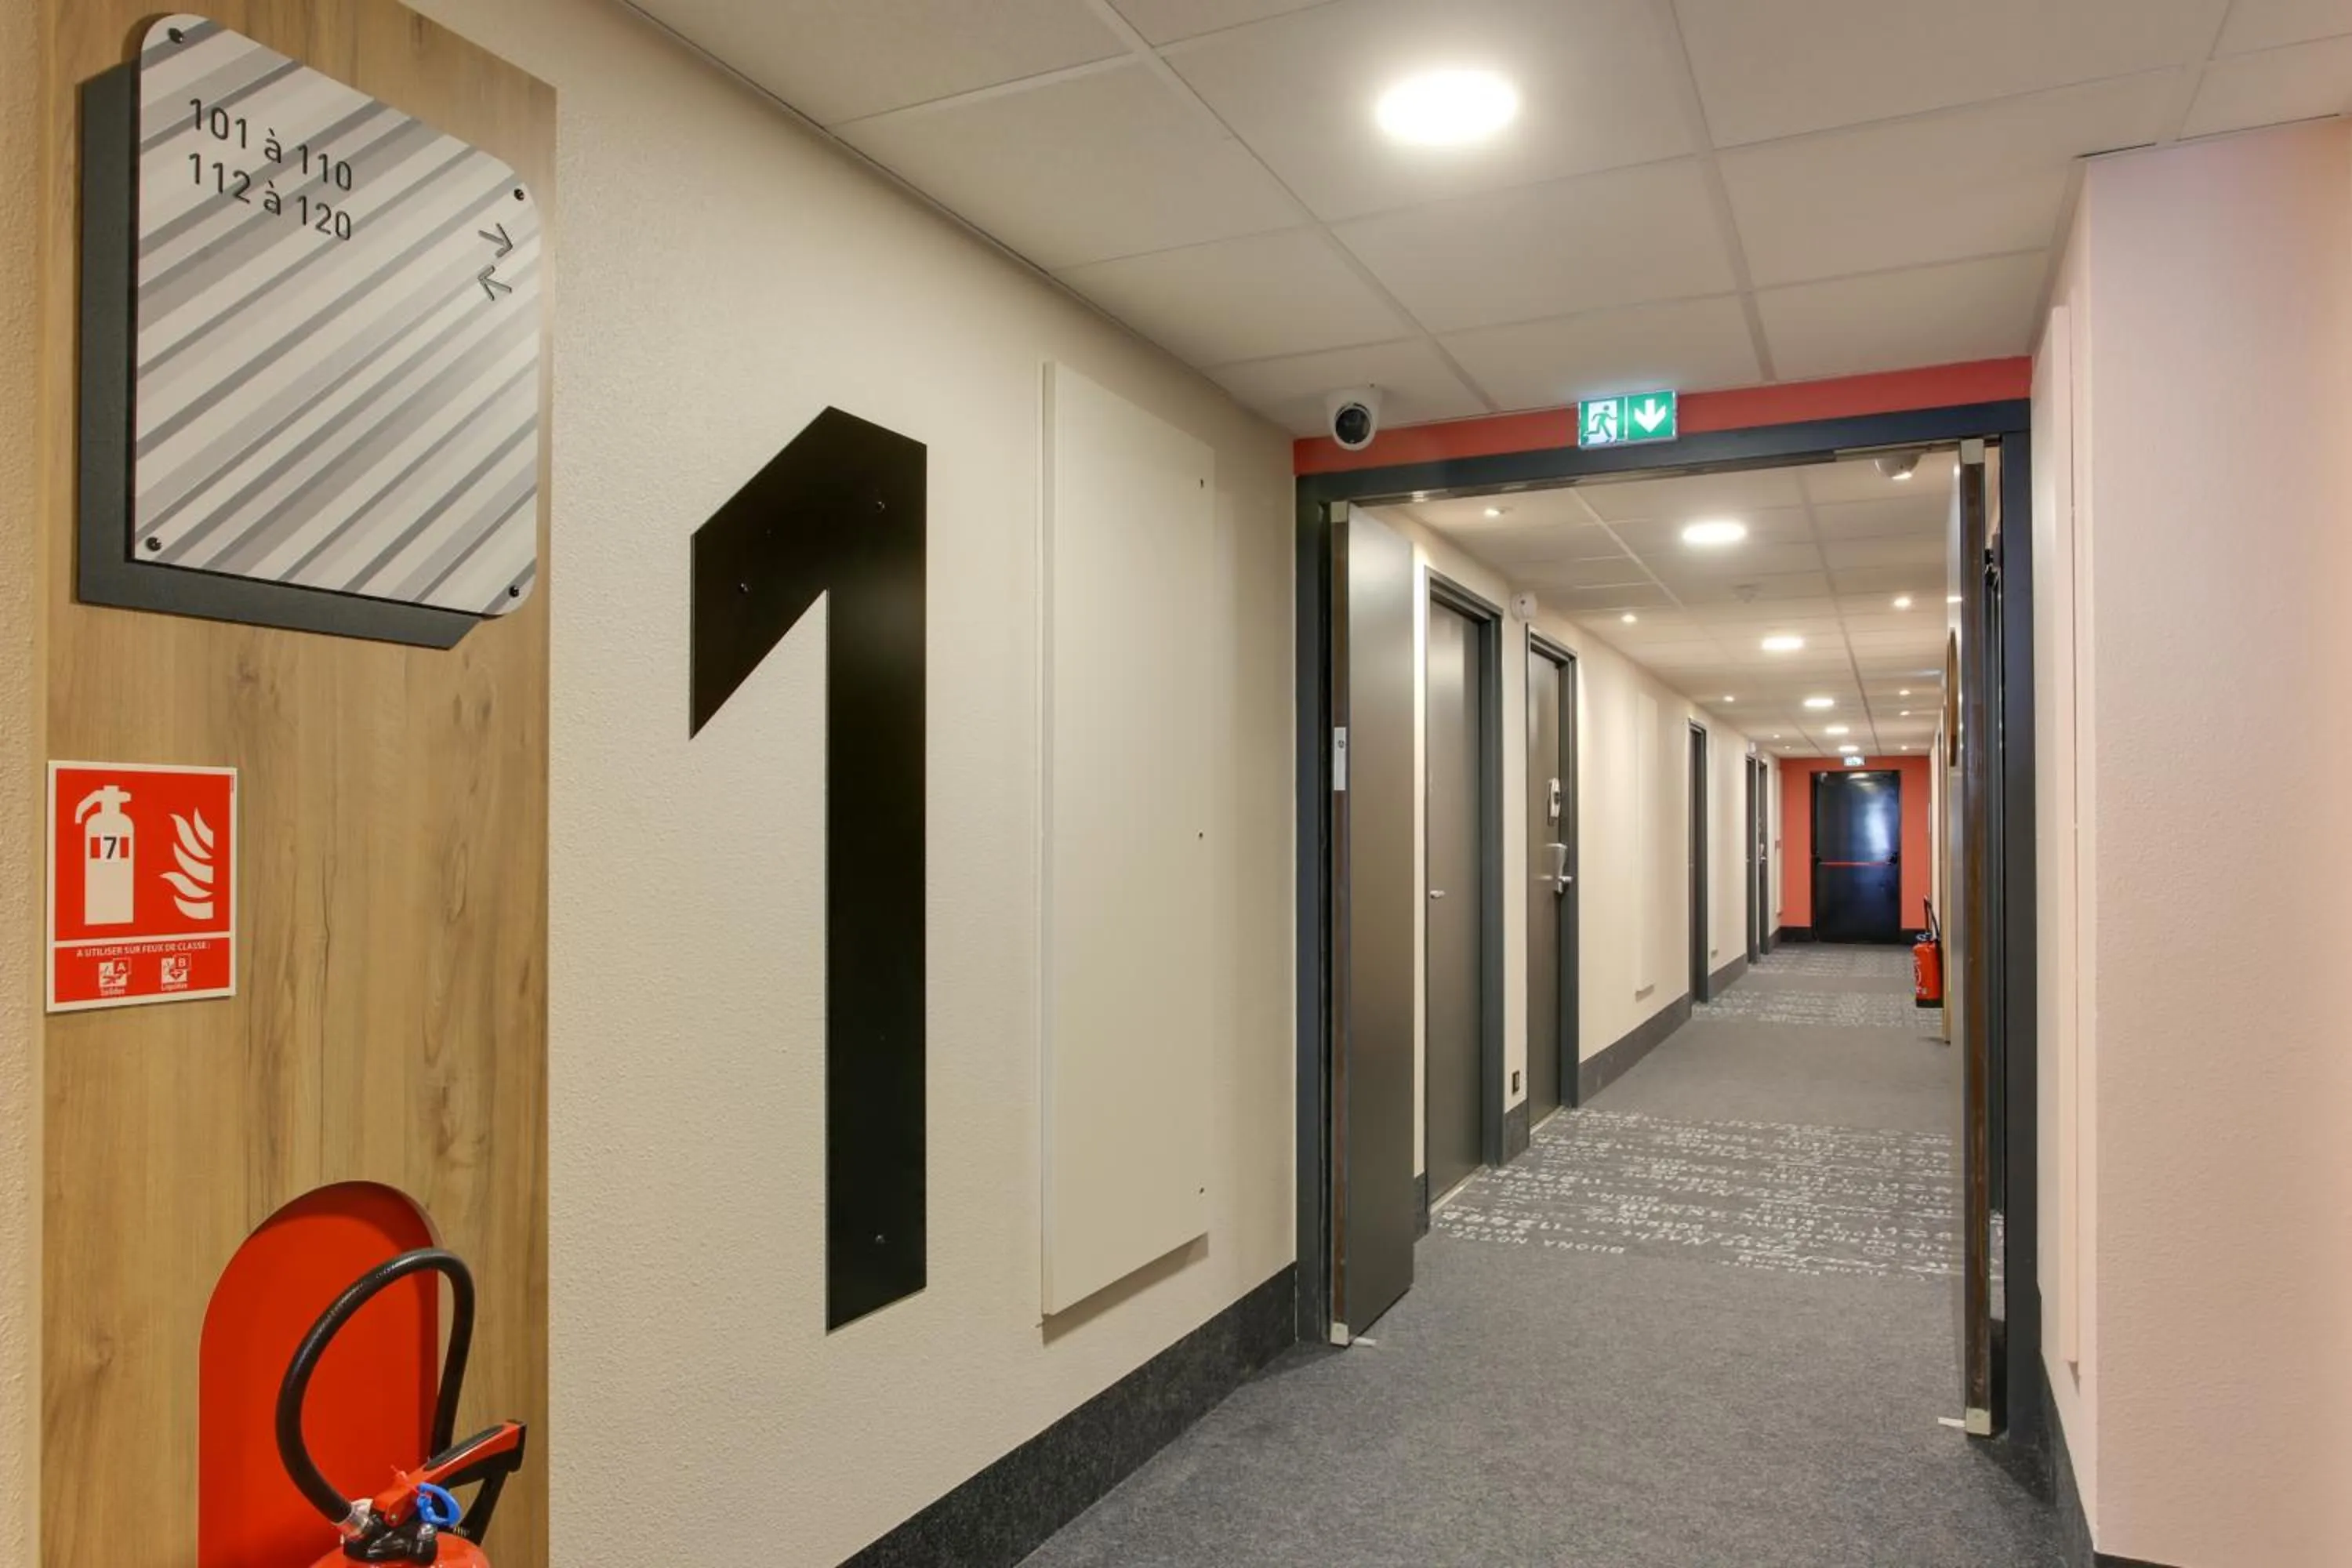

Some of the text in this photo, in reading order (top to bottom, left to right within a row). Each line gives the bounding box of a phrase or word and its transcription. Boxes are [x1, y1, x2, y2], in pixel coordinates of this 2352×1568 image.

[190, 98, 352, 191] 101 à 110
[189, 153, 351, 241] 112 à 120
[103, 837, 118, 859] 7
[690, 405, 927, 1335] 1
[125, 946, 140, 954] SUR
[117, 961, 126, 972] A
[178, 957, 187, 967] B
